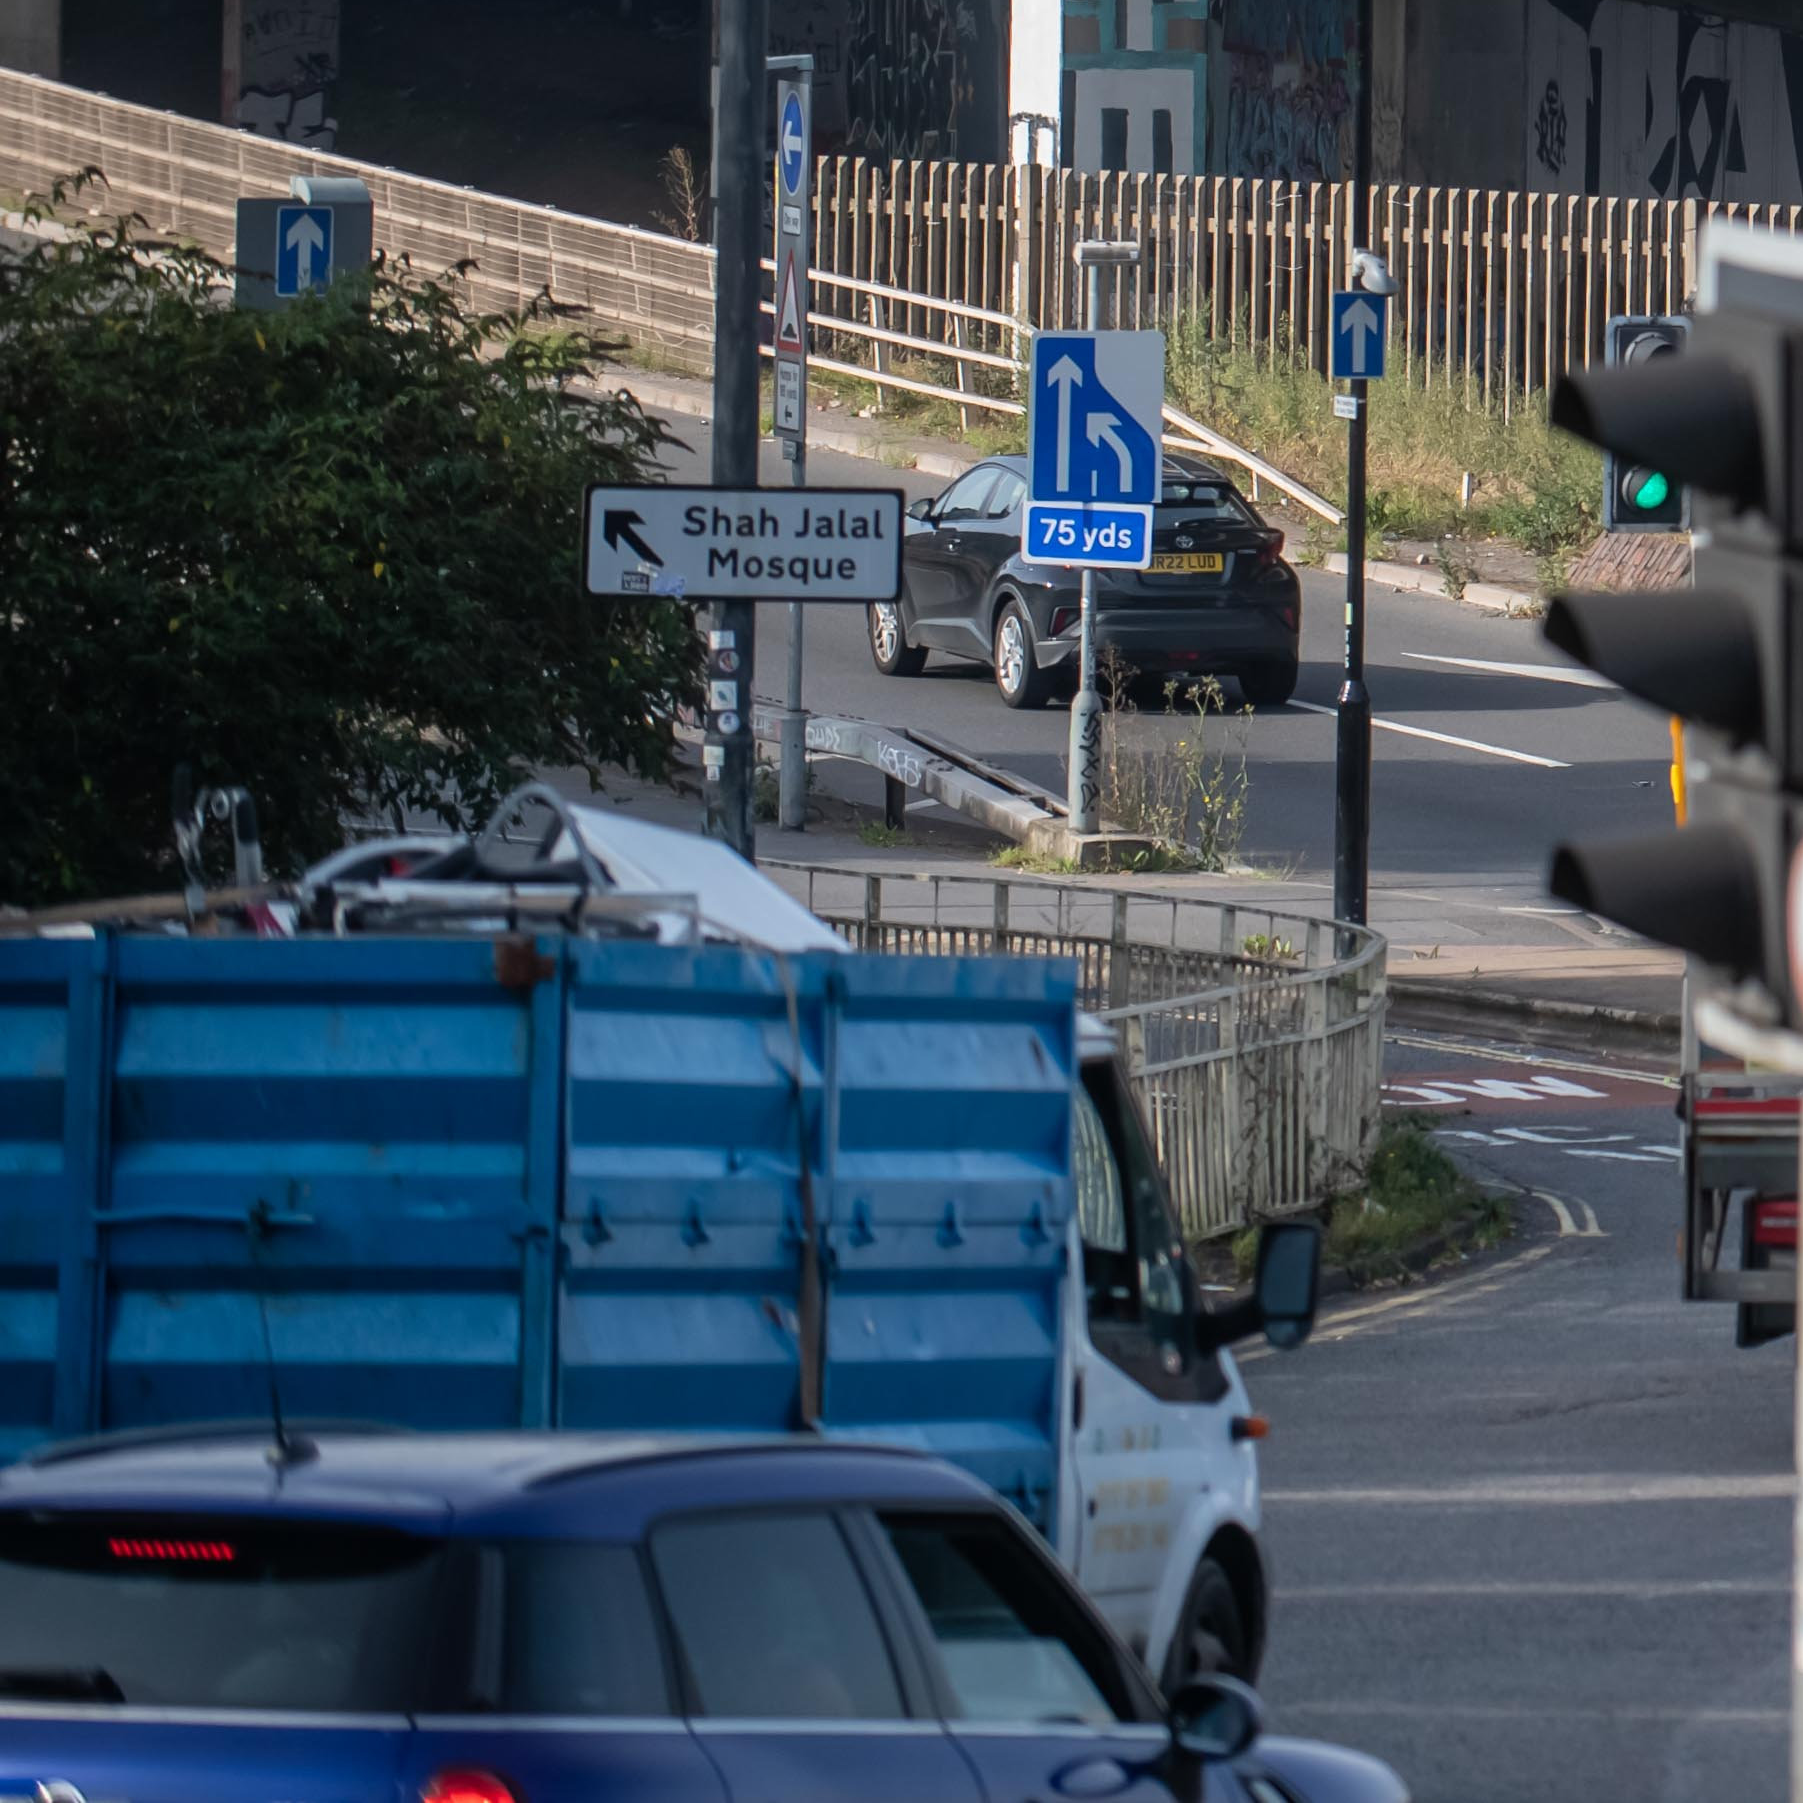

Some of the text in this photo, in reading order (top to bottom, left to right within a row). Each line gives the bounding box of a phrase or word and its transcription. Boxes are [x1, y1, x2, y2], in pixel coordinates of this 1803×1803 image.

[682, 505, 884, 540] Shah Jalal
[1040, 518, 1132, 552] 75 yds
[707, 547, 857, 585] Mosque
[1189, 552, 1217, 569] LUD
